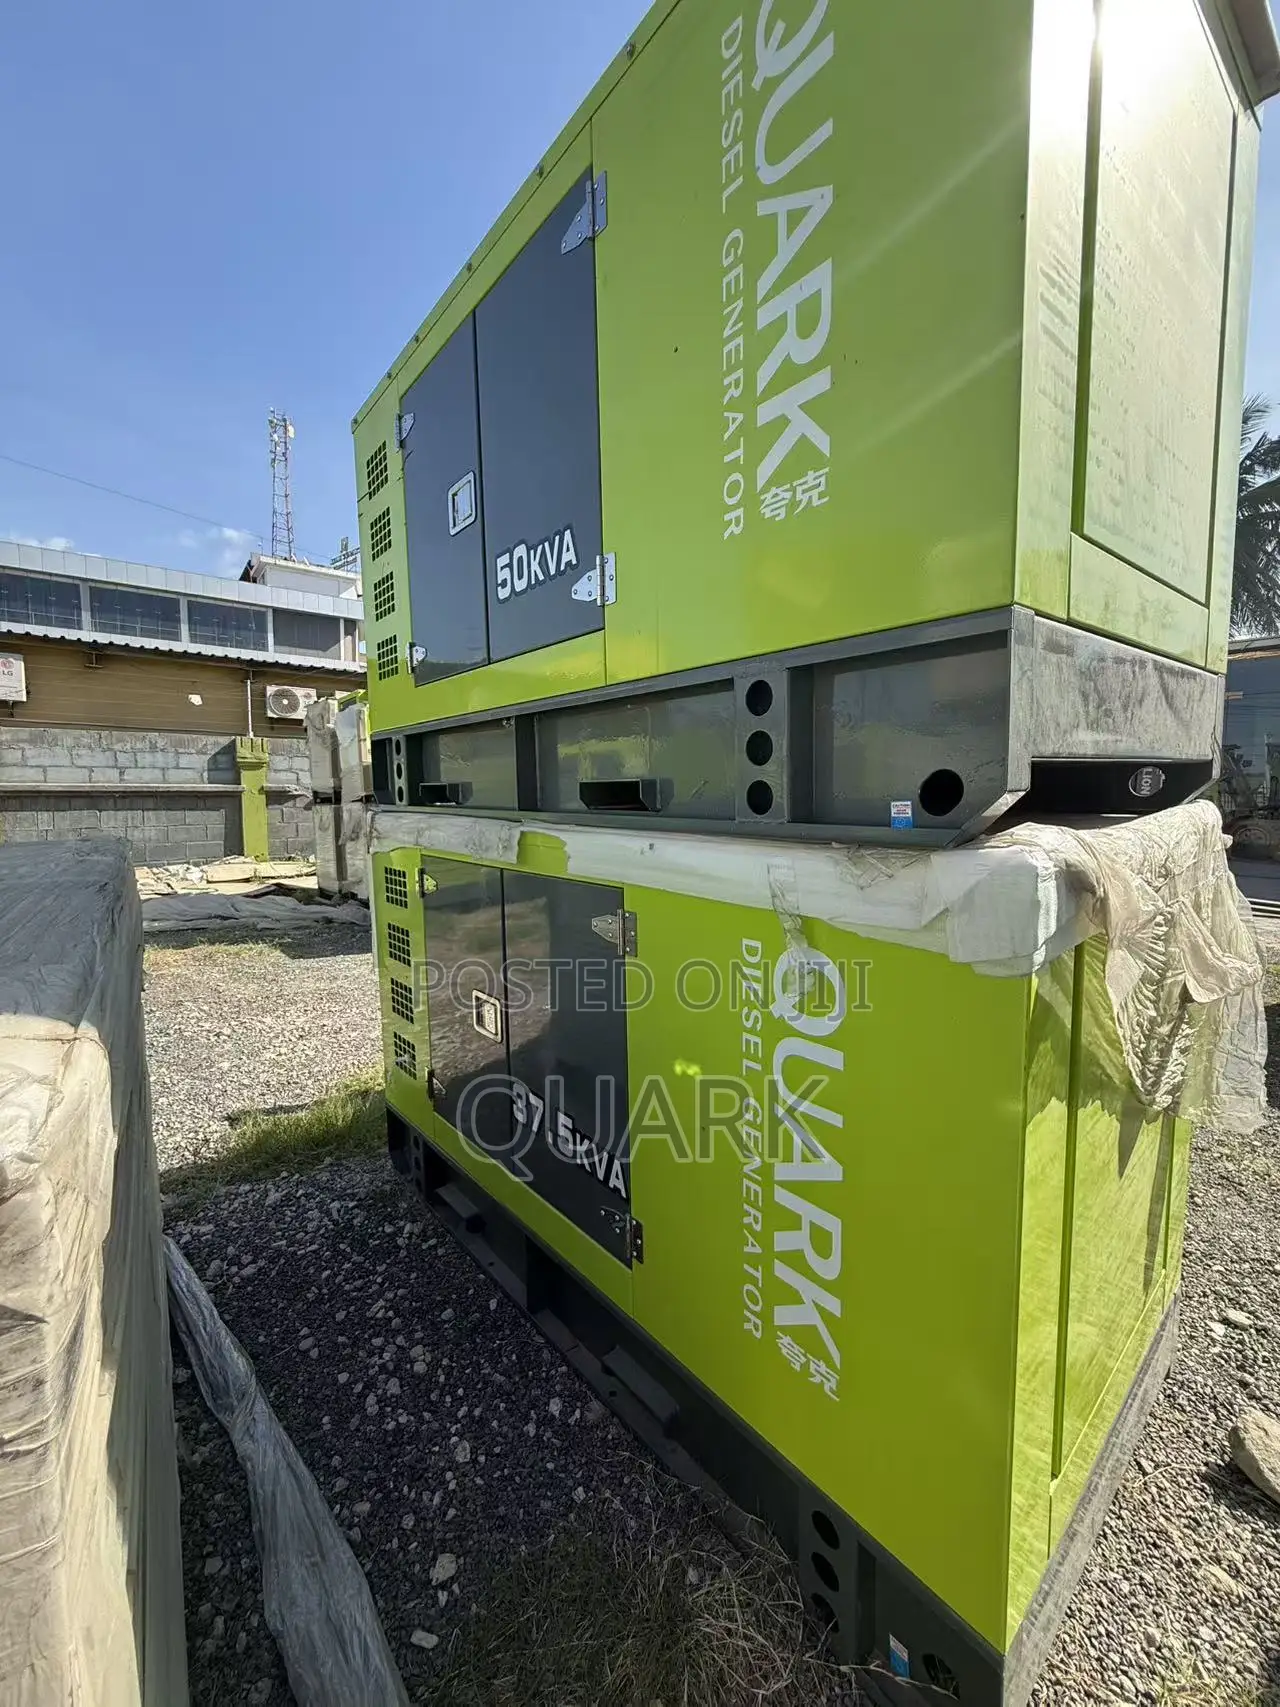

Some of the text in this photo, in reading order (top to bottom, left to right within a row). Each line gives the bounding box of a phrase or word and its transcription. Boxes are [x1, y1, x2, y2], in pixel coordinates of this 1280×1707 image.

[721, 15, 745, 540] DIESEL GENERATOR
[759, 467, 830, 521] 夸克
[496, 529, 577, 600] 50KVA
[1140, 768, 1152, 795] LION
[742, 938, 762, 1340] DIESEL GENERATOR
[771, 946, 846, 1370] QUARK
[775, 1331, 840, 1402] 夸克
